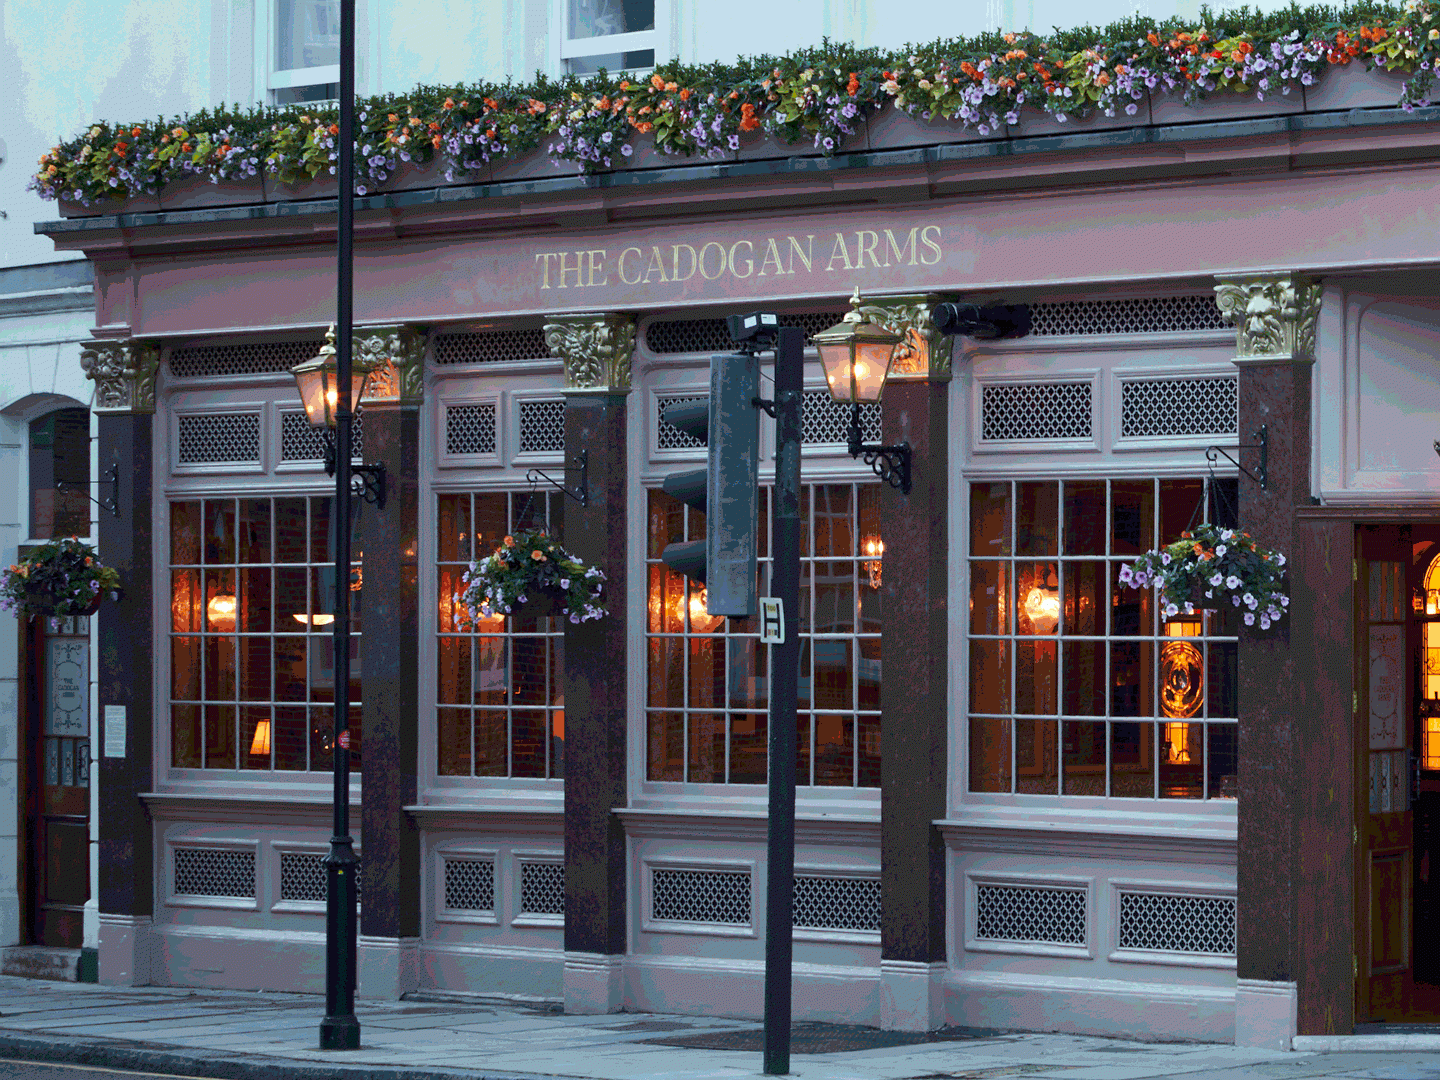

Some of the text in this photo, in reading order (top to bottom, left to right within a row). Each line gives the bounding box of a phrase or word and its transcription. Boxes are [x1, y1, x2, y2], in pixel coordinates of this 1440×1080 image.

[535, 225, 942, 289] THE CADOGAN ARMS
